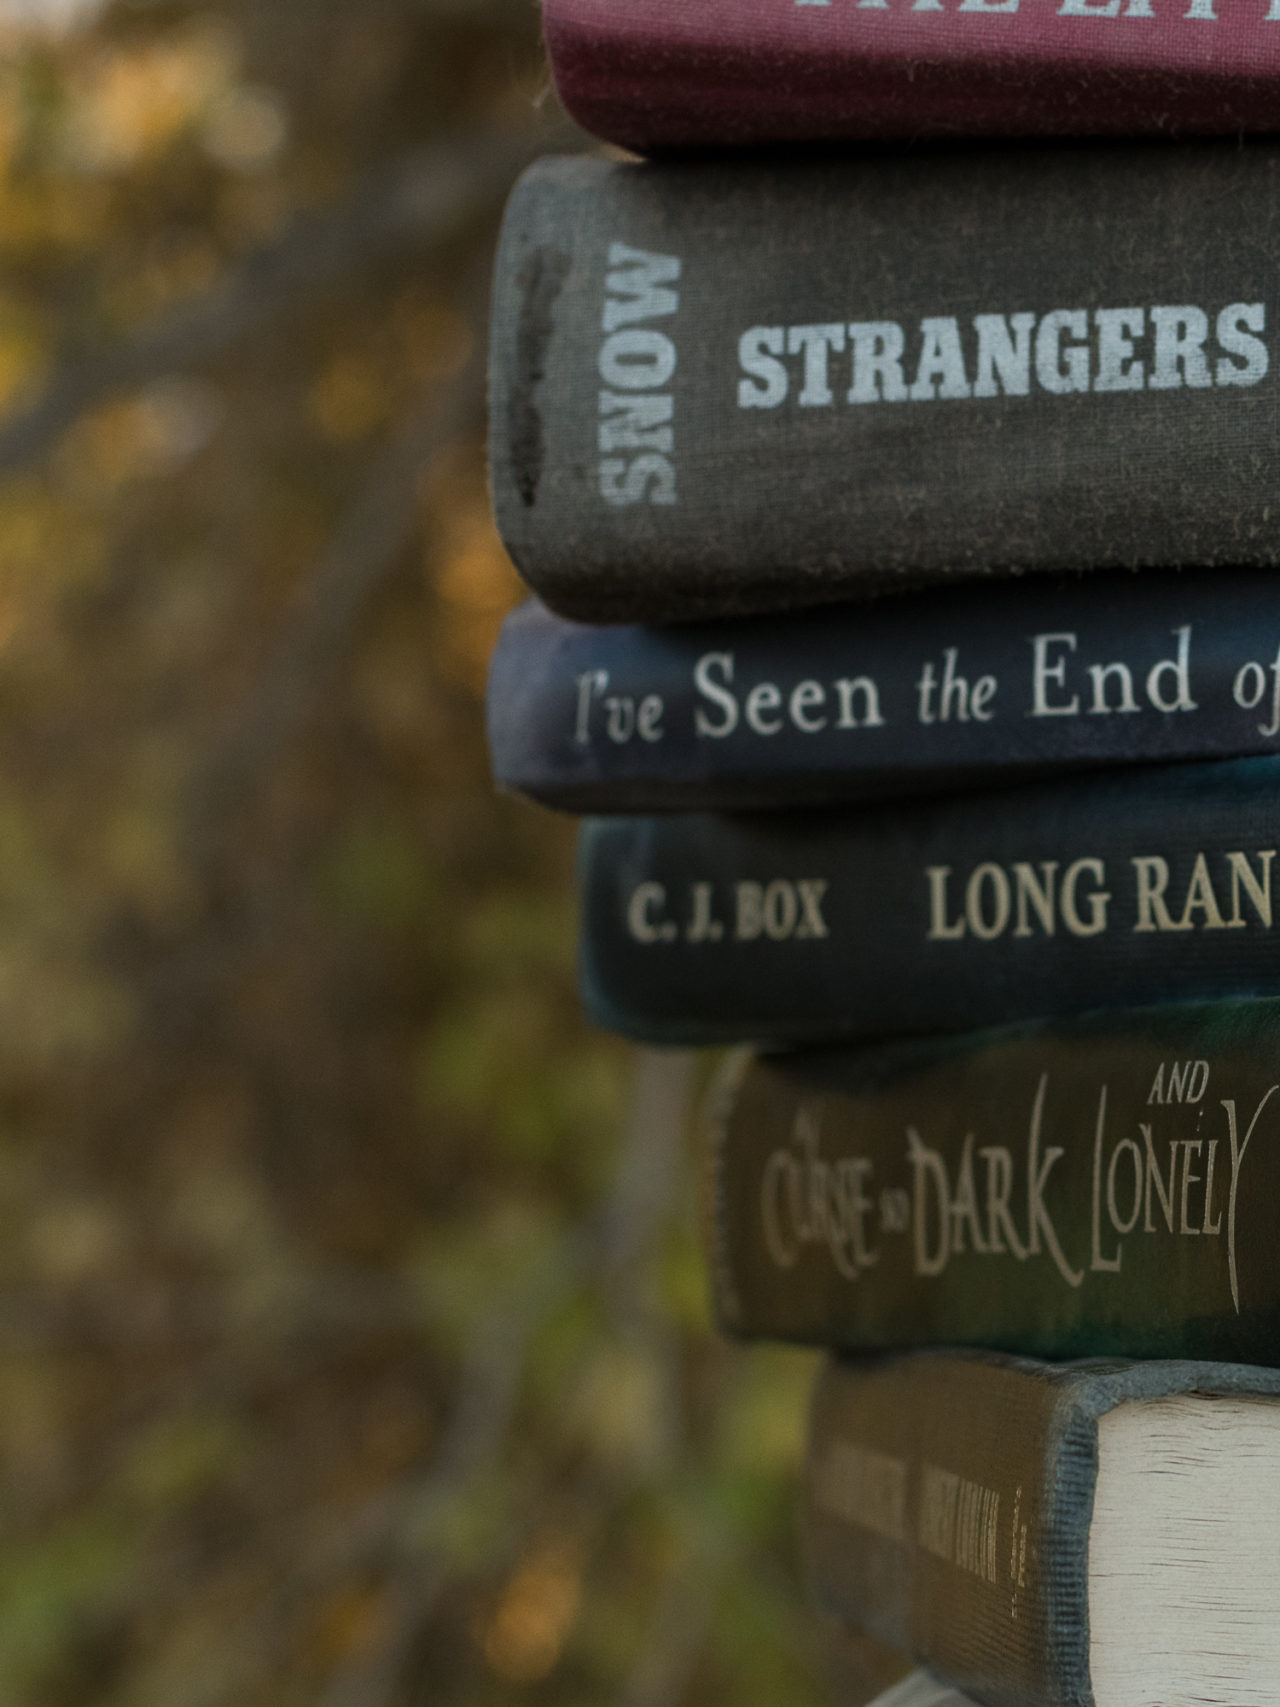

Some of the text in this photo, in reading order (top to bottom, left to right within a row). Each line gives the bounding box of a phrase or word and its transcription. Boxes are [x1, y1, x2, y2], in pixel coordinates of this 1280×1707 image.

[598, 243, 681, 507] SNOW
[738, 303, 1269, 408] STRANGERS
[572, 668, 664, 746] I've
[694, 656, 883, 736] Seen
[915, 647, 998, 724] the
[1034, 627, 1196, 716] End
[735, 879, 829, 940] BOX
[929, 858, 1111, 939] LONG
[1147, 1060, 1210, 1104] AND
[905, 1073, 1084, 1287] DARK
[1090, 1084, 1280, 1315] LONELY
